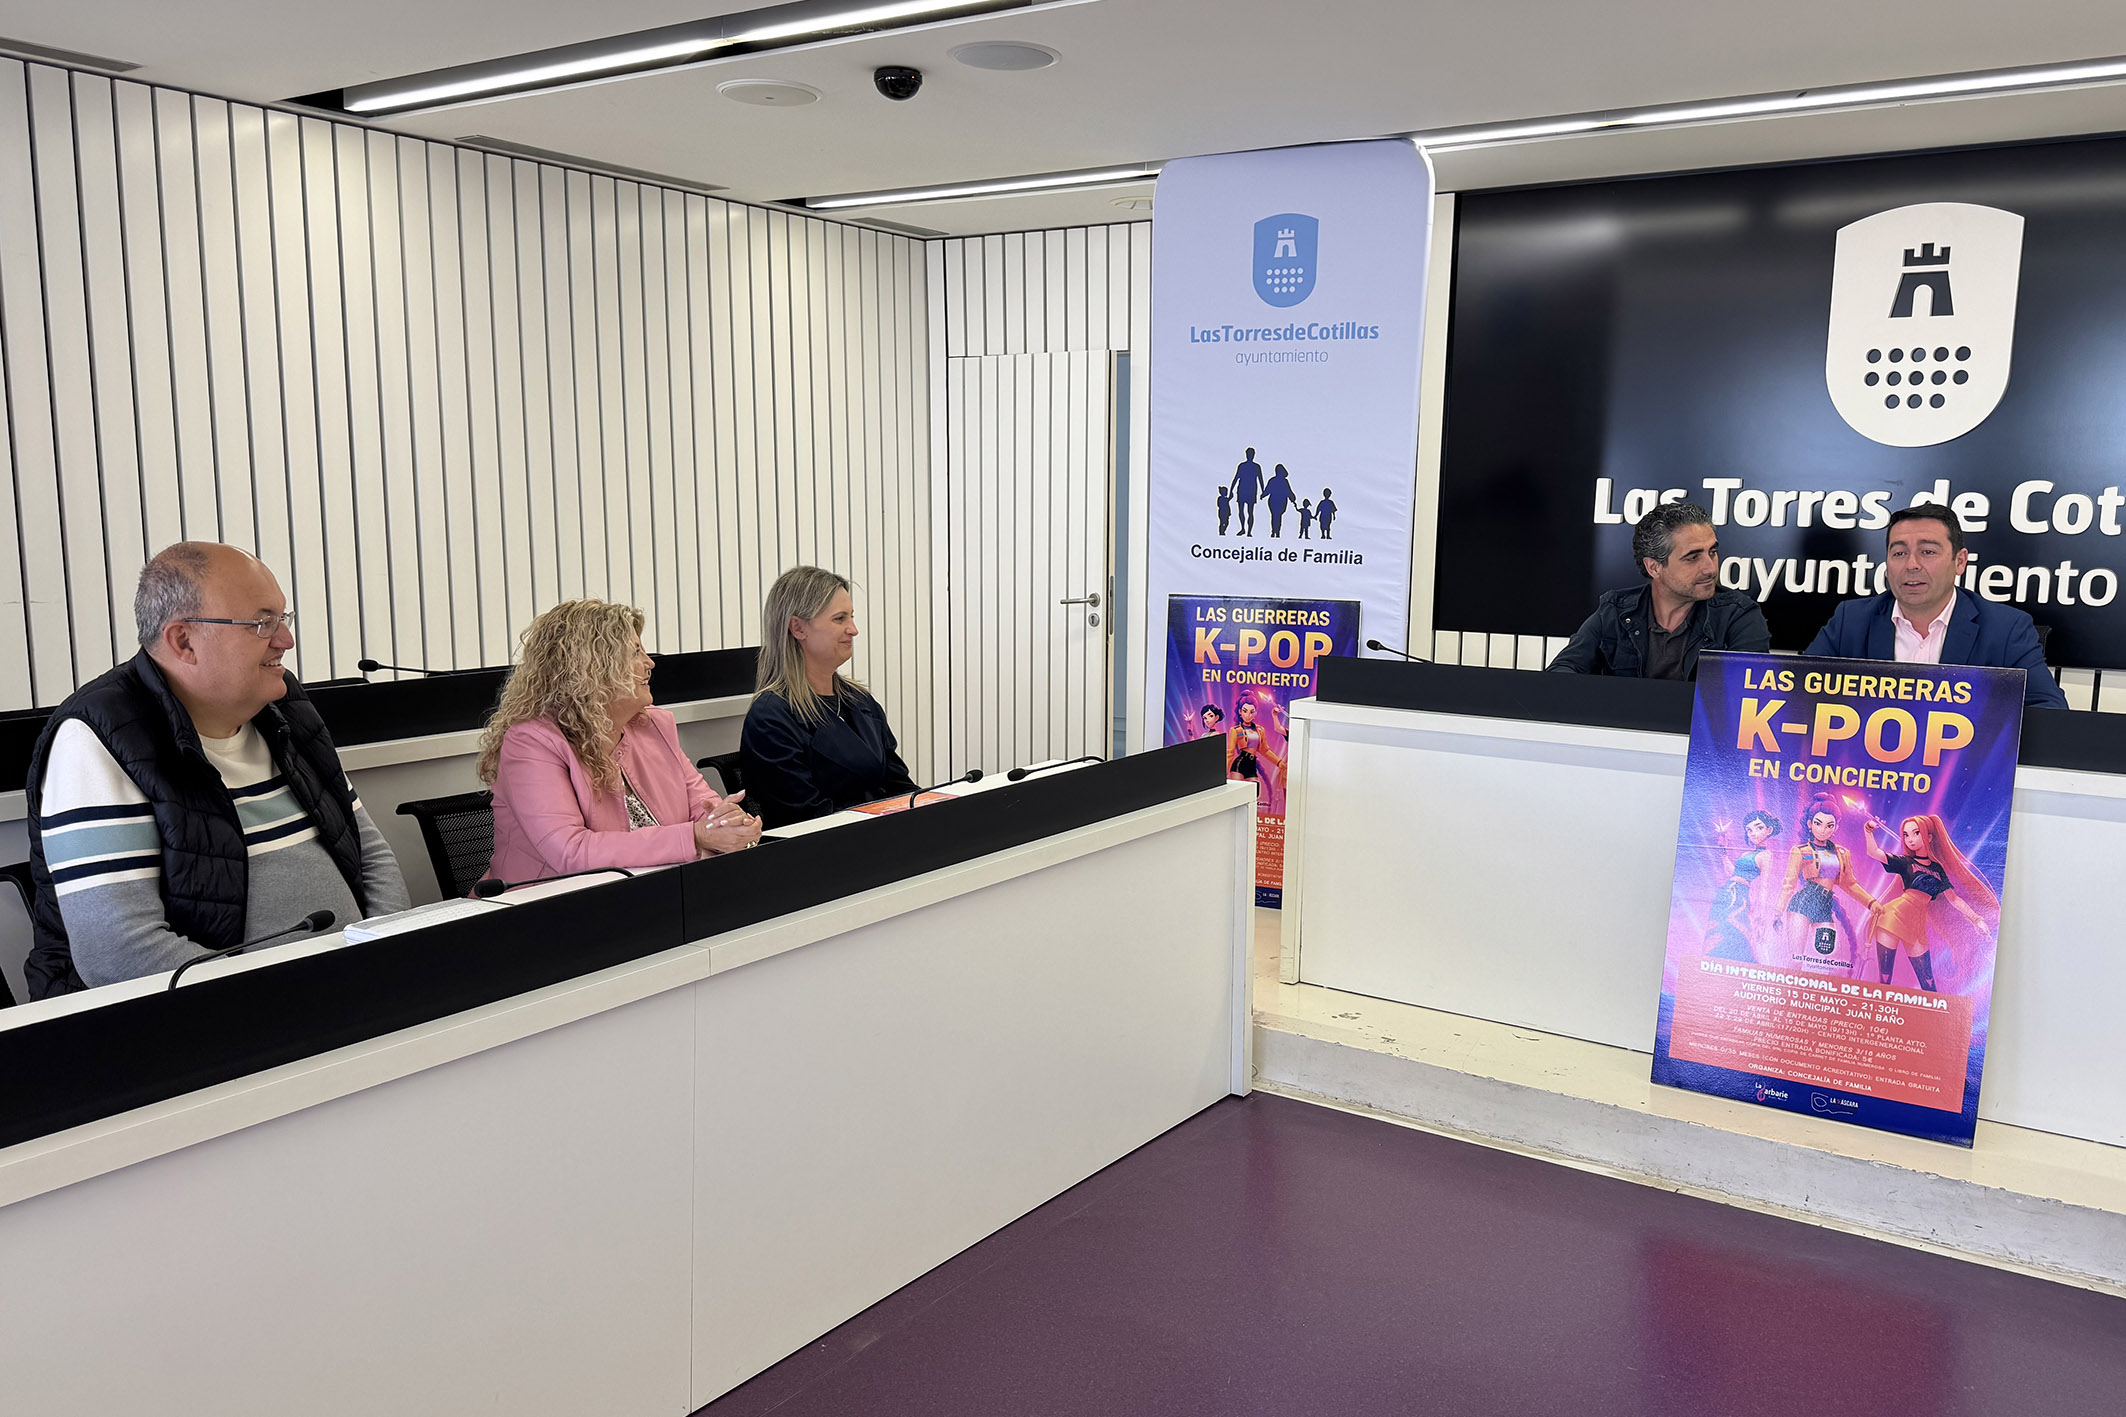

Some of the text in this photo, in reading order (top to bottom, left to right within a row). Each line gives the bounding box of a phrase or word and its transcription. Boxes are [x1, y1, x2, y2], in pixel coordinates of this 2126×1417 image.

[1190, 321, 1379, 343] LasTorresdeCotillas
[1235, 348, 1329, 367] ayuntamiento
[1702, 478, 1892, 530] Torres
[1190, 544, 1363, 565] Concejalía de Familia
[1719, 553, 2118, 607] ayuntiento
[1196, 606, 1330, 626] LAS GUERRERAS
[1194, 627, 1333, 669] K-POP
[1202, 669, 1310, 688] EN CONCIERTO
[1744, 668, 1972, 704] LAS GUERRERAS
[1737, 698, 1975, 767] K-POP
[1748, 758, 1931, 793] EN CONCIERTO
[1700, 960, 1948, 1010] DÍA INTERNACIONAL DE LA FAMILIA
[1741, 982, 1782, 995] VIERNES
[1787, 990, 1799, 999] 15
[1802, 993, 1816, 1001] DE
[1820, 995, 1848, 1007] MAYO
[1861, 1002, 1899, 1015] 21.30H
[1733, 990, 1905, 1026] AUDITORIO MUNICIPAL JUAN BAÑO
[1747, 1005, 1770, 1014] VENTA
[1787, 1012, 1828, 1024] ENTRADAS
[1830, 1019, 1865, 1031] (PRECIO:
[1869, 1026, 1889, 1035] 10€)
[1753, 1037, 1779, 1046] PRECIO
[1781, 1042, 1813, 1052] ENTRADA
[1766, 1032, 1808, 1045] NUMEROSAS
[1818, 1042, 1853, 1053] MENORES
[1875, 1052, 1896, 1061] AÑOS
[1808, 1022, 1827, 1031] MAYO
[1877, 1034, 1904, 1044] PLANTA
[1817, 1030, 1846, 1040] CENTRO
[1849, 1036, 1924, 1054] INTERGENERACIONAL
[1781, 1058, 1820, 1070] DOCUMENTO
[1875, 1076, 1905, 1086] ENTRADA
[1908, 1082, 1940, 1092] GRATUITA
[1788, 1070, 1830, 1083] CONCEJALÍA
[1845, 1081, 1872, 1091] FAMILIA
